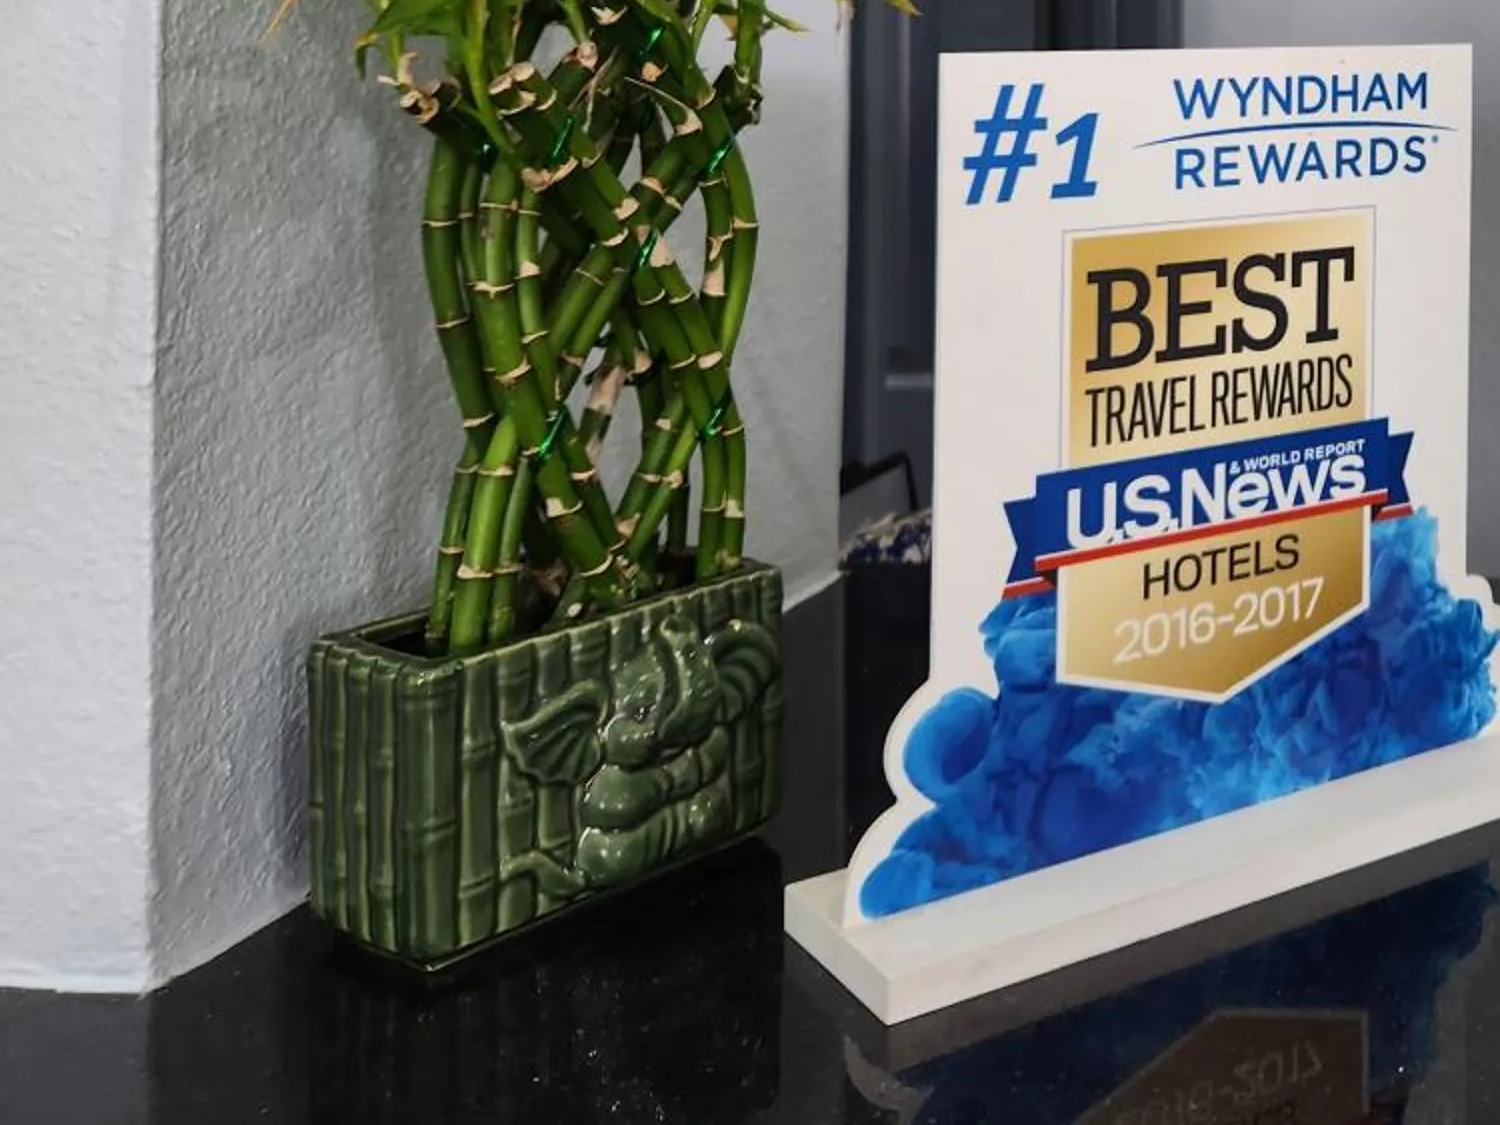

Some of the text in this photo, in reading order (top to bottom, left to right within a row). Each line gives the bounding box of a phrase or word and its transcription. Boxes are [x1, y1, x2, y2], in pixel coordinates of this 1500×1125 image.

[1173, 73, 1427, 120] WYNDHAM
[962, 83, 1100, 205] #1
[1175, 136, 1427, 190] REWARDS
[1085, 247, 1354, 373] BEST
[1085, 354, 1352, 448] TRAVEL REWARDS
[1229, 438, 1365, 473] & WORLD REPORT
[1142, 534, 1299, 600] HOTELS
[1113, 578, 1323, 666] 2016-2017
